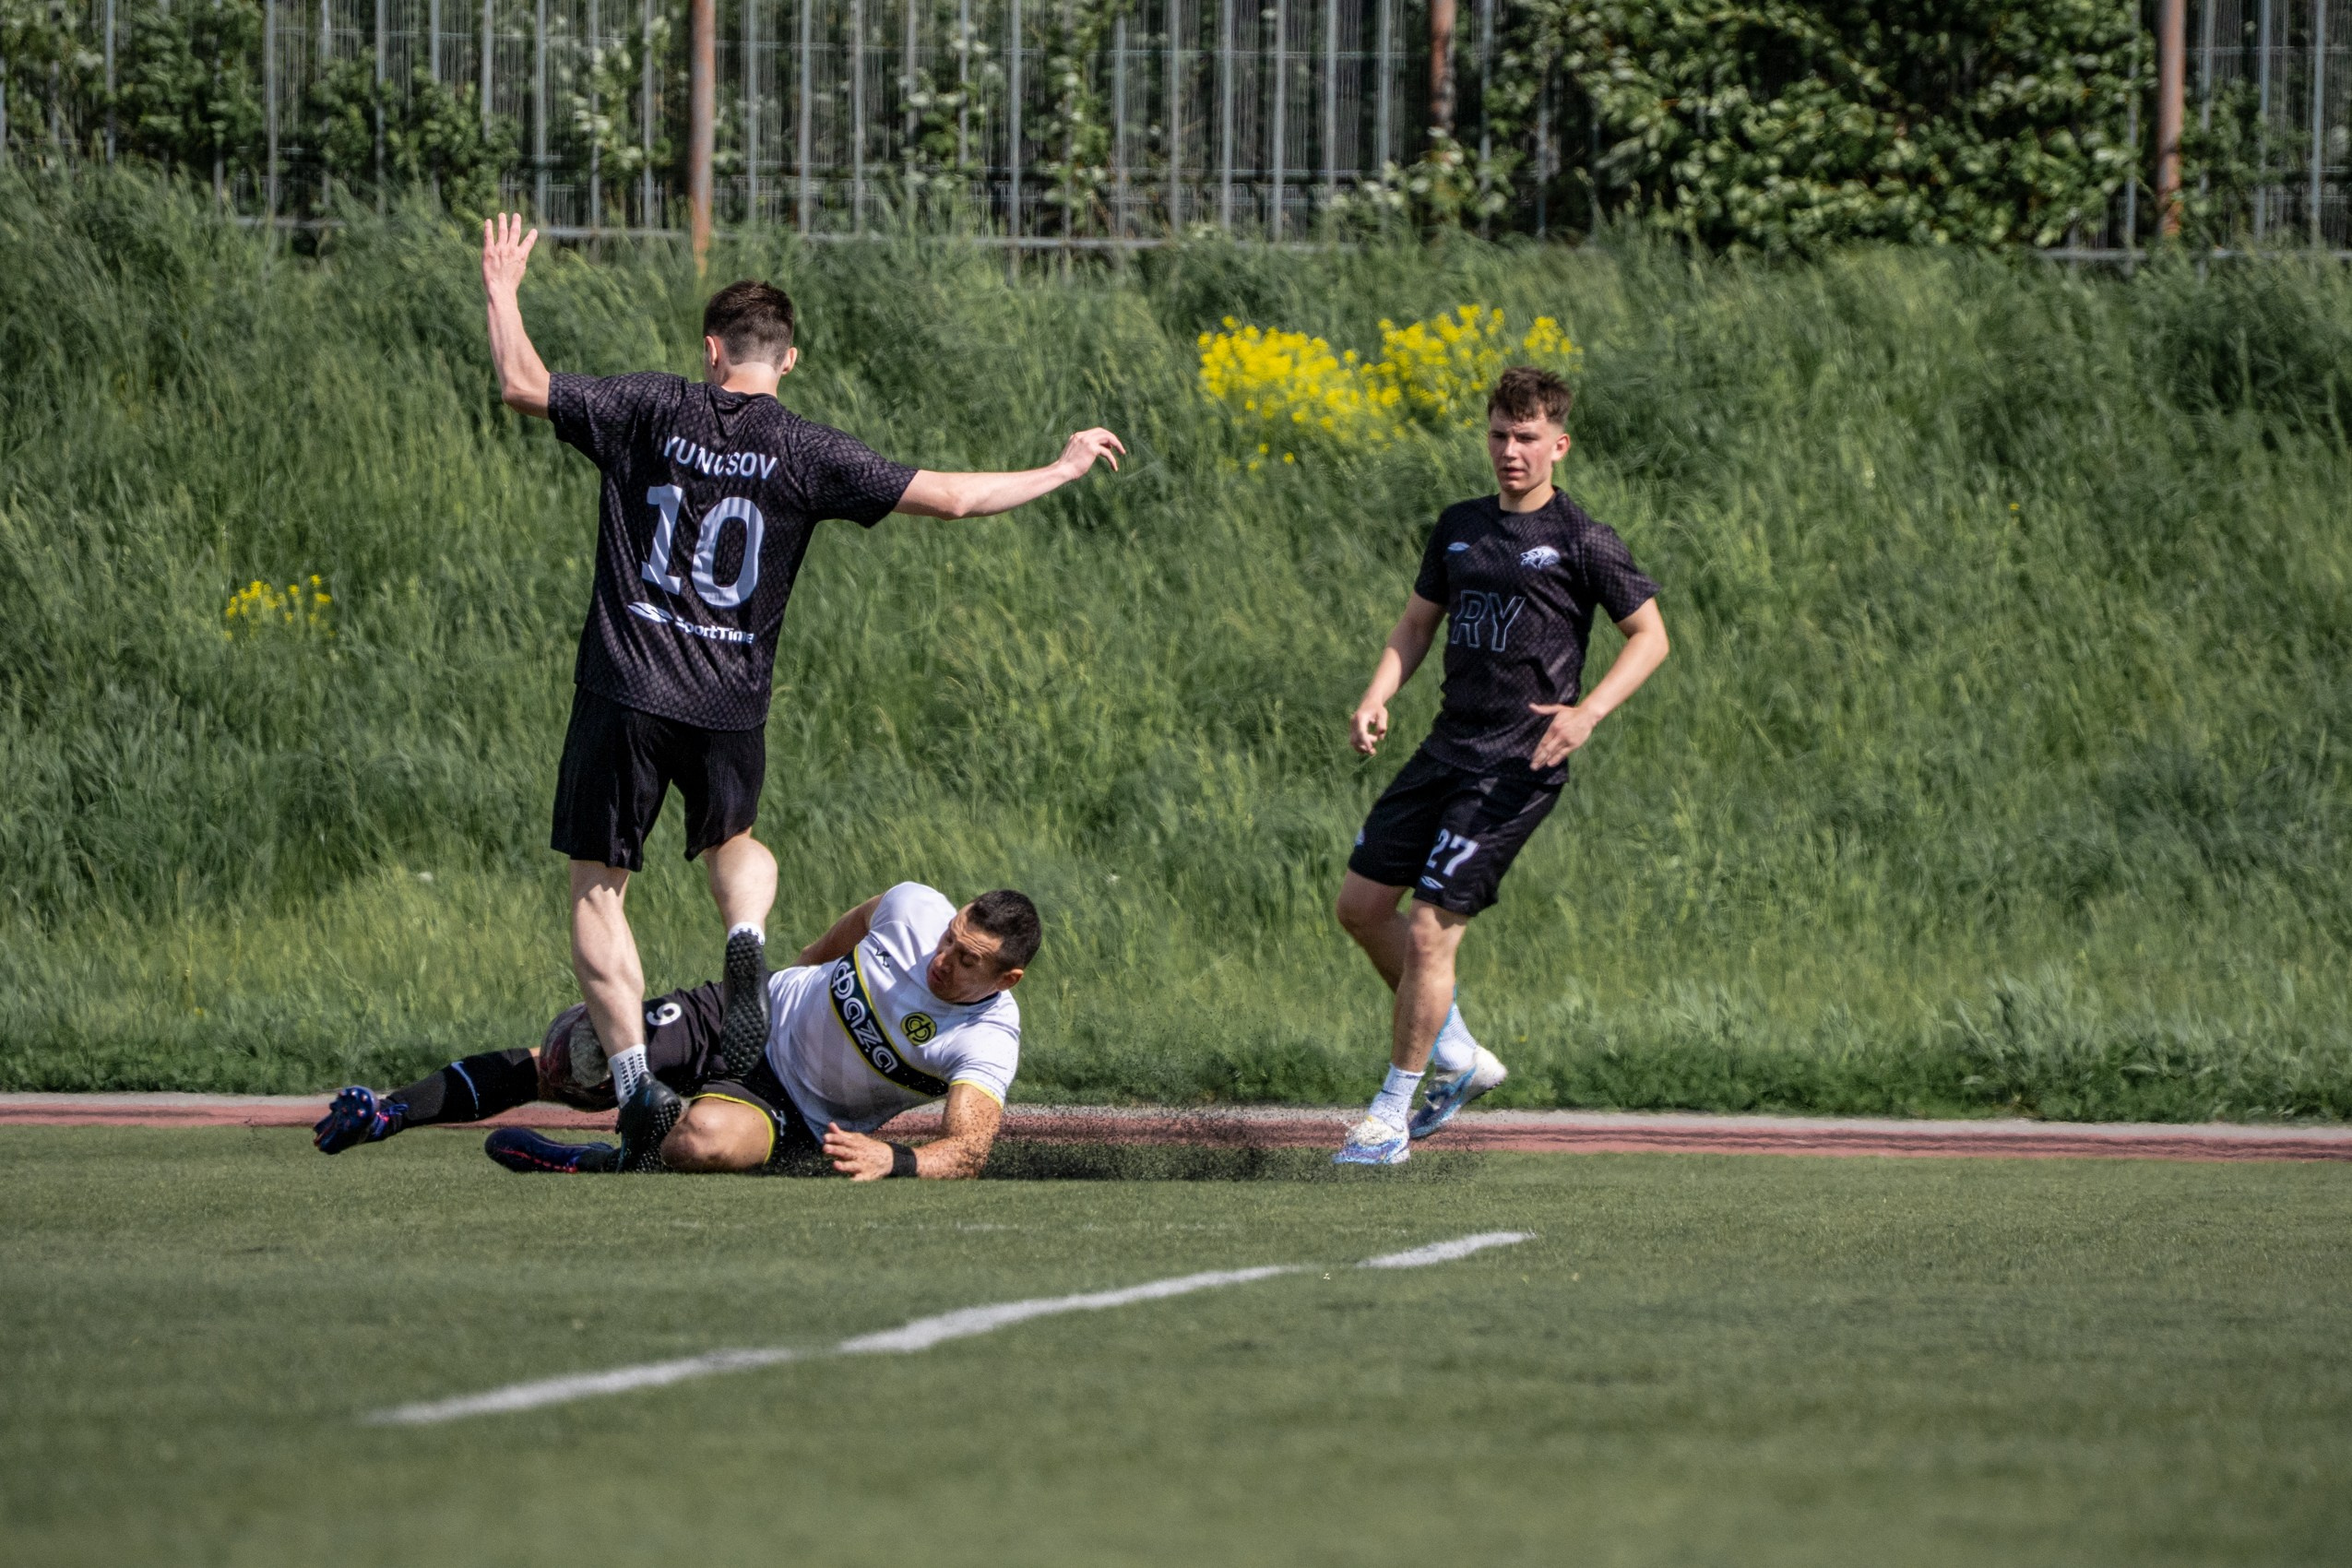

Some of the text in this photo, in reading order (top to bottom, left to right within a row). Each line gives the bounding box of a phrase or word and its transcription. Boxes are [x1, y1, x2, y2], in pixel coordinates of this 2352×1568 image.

[641, 482, 765, 609] 10
[1450, 588, 1527, 653] RY
[1426, 828, 1480, 877] 27
[646, 1002, 682, 1027] 9
